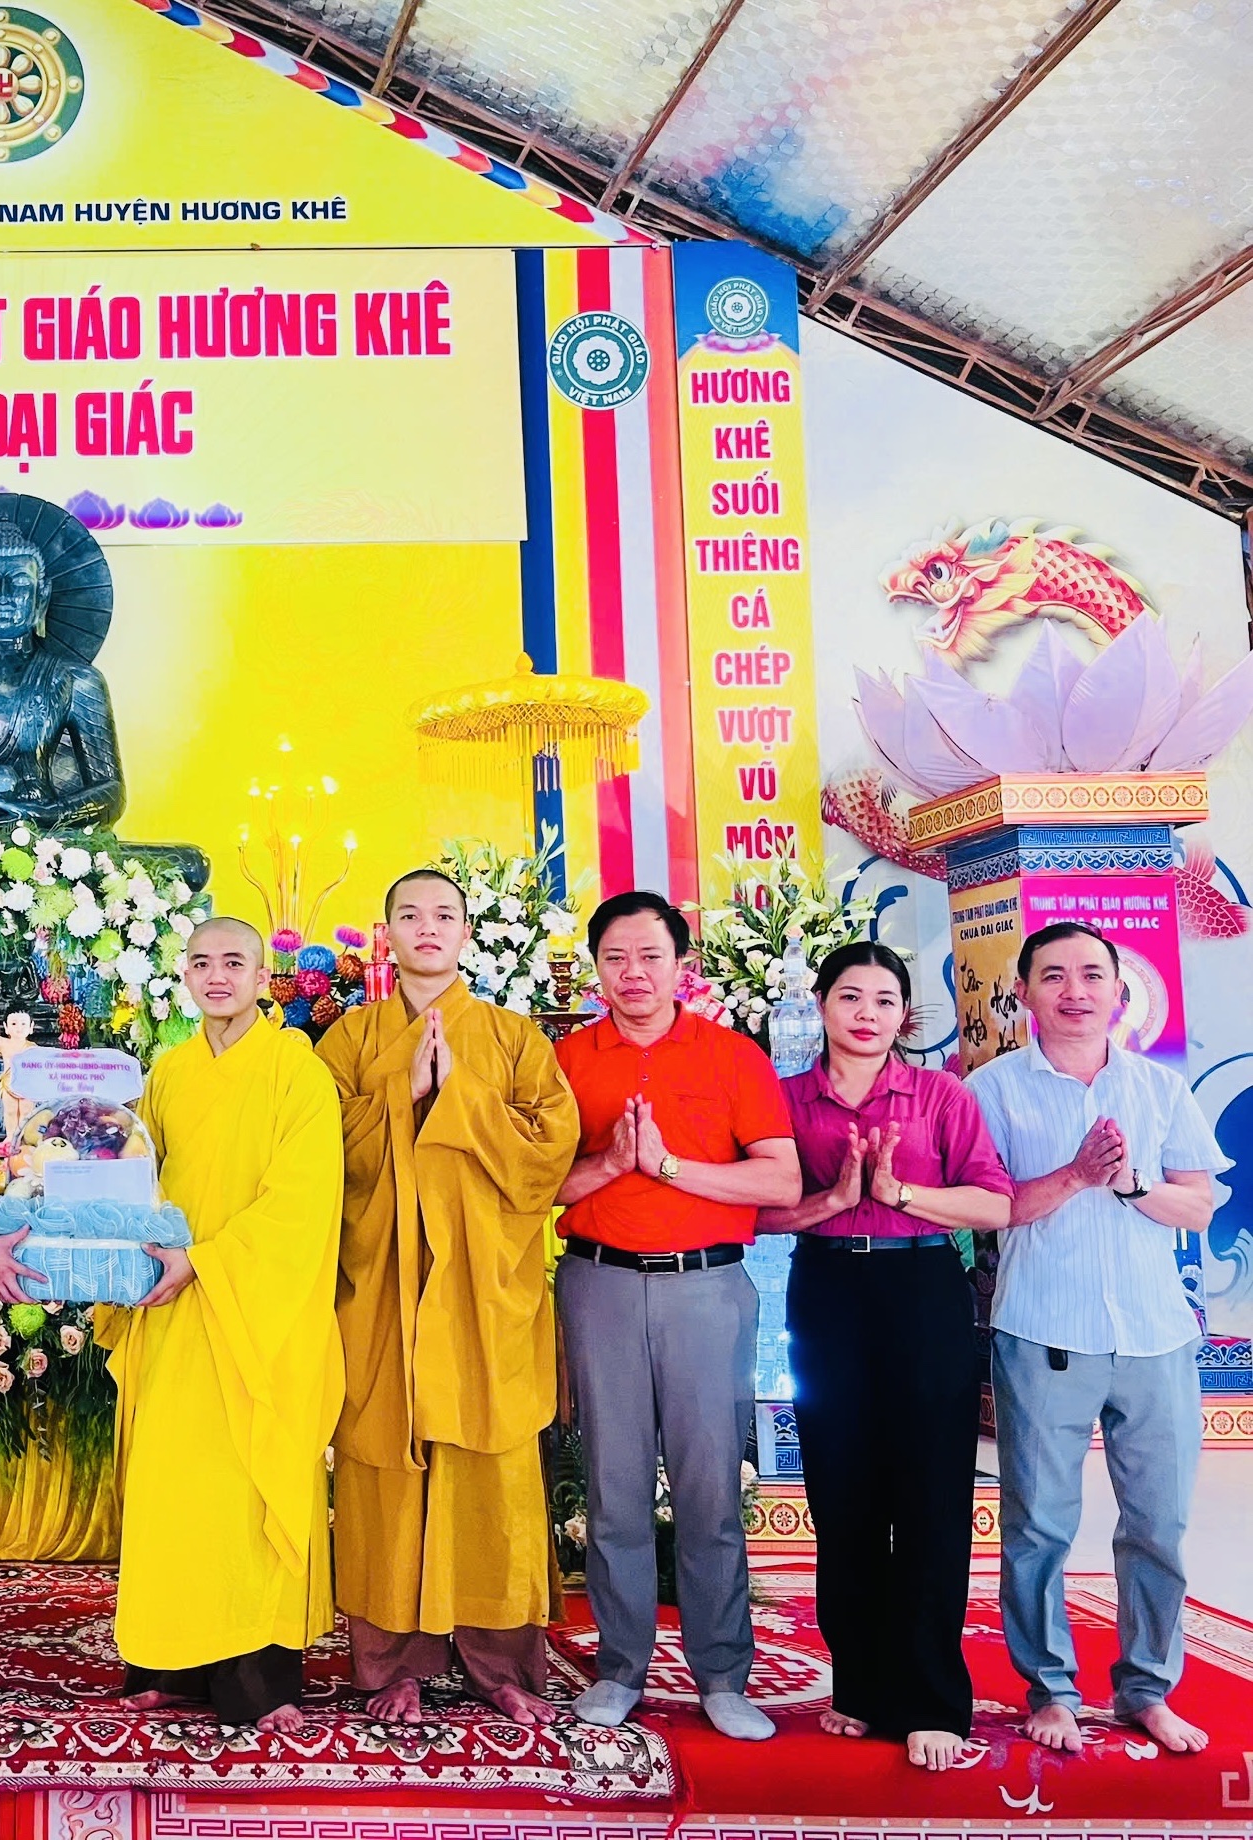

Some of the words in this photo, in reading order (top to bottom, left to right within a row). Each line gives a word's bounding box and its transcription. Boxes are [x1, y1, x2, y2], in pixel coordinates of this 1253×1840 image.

[75, 198, 170, 225] HUYỆN
[181, 200, 281, 221] HƯƠNG
[292, 197, 347, 219] KHÊ
[23, 285, 140, 360] GIÁO
[158, 286, 337, 359] HƯƠNG
[355, 280, 451, 356] KHÊ
[551, 333, 568, 364] GIÁO
[566, 317, 590, 334] HỘI
[593, 315, 629, 333] PHẬT
[627, 333, 647, 364] GIÁO
[568, 386, 599, 406] VIỆT
[602, 387, 632, 404] NAM
[691, 368, 790, 404] HƯƠNG
[75, 379, 193, 455] GIÁC
[715, 420, 771, 459] KHÊ
[712, 470, 779, 515] SUỐI
[695, 532, 802, 571] THIÊNG
[731, 588, 771, 628] CÁ
[714, 645, 790, 685] CHÉP
[718, 706, 792, 750] VƯỢT
[739, 761, 776, 801] VŨ
[726, 818, 795, 859] MÔN
[1029, 896, 1057, 910] TRUNG
